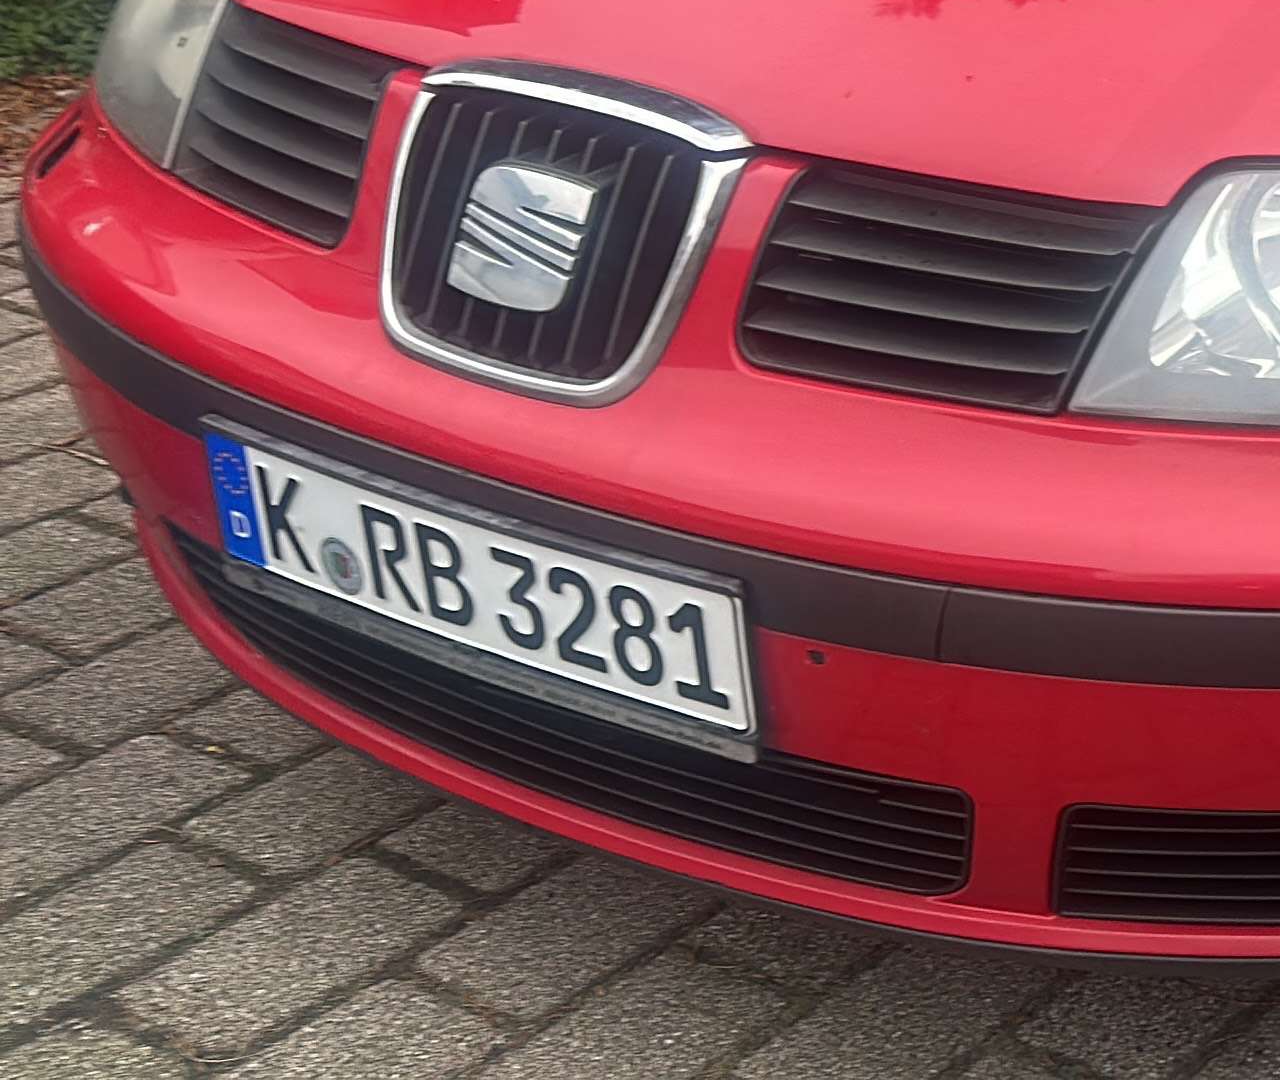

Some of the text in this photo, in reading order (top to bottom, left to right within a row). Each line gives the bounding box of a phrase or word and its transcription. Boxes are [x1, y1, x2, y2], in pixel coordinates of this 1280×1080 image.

[254, 464, 730, 710] K RB 3281
